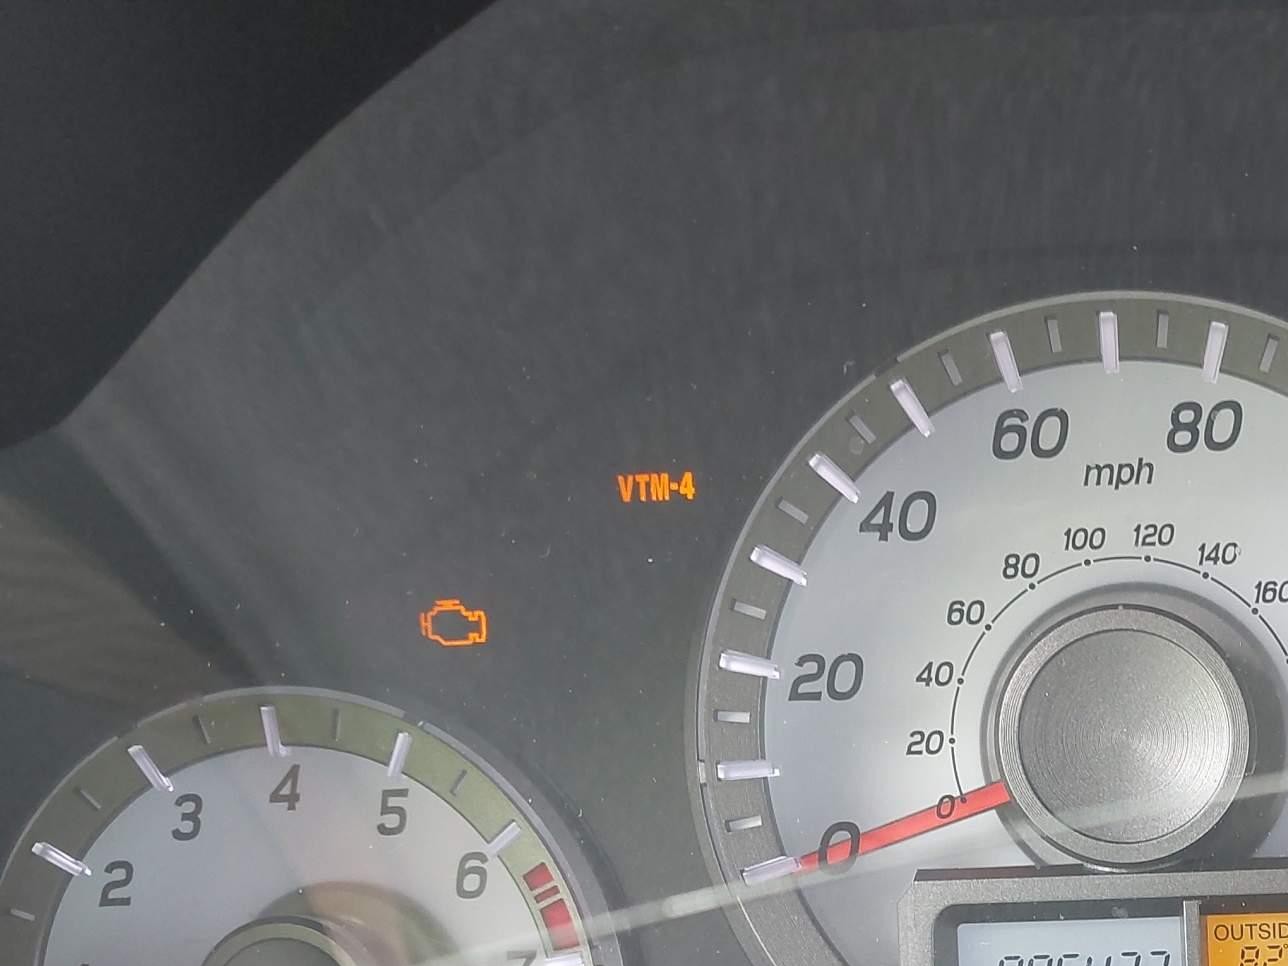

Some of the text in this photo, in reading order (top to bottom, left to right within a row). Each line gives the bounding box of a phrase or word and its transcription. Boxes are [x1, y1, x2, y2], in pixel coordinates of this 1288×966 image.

[991, 408, 1069, 460] 60
[1166, 400, 1243, 453] 80
[617, 472, 695, 502] VTM-4
[1083, 457, 1155, 491] mph
[859, 490, 937, 542] 40
[1133, 523, 1175, 547] 120
[1063, 527, 1107, 551] 100
[1197, 541, 1240, 566] 140
[1002, 554, 1040, 580] 80
[946, 600, 985, 627] 60
[789, 652, 864, 702] 20
[915, 661, 954, 688] 40
[906, 730, 944, 756] 20
[269, 763, 301, 811] 4
[936, 793, 954, 820] 0
[171, 793, 203, 841] 3
[376, 788, 409, 836] 5
[817, 821, 862, 874] 0
[99, 860, 135, 907] 2
[455, 851, 489, 899] 6
